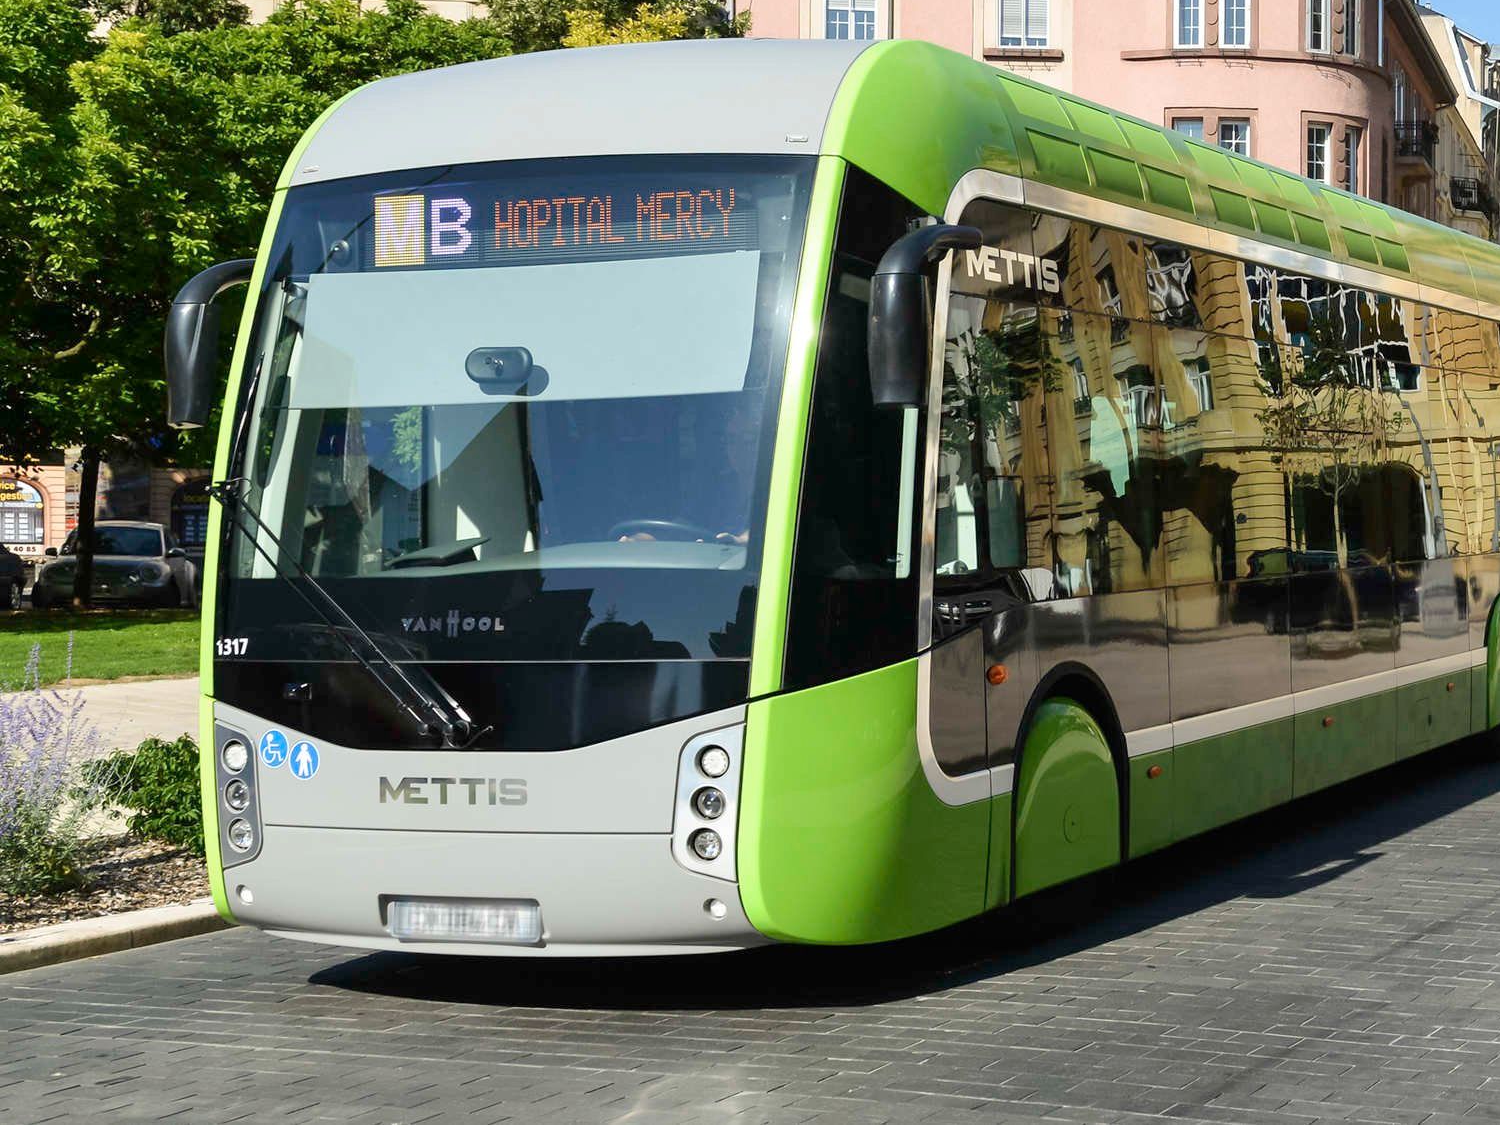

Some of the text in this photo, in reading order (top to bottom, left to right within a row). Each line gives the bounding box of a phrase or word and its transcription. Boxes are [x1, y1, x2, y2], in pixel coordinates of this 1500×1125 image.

[377, 187, 736, 262] M B HOPITAL MERCY
[965, 245, 1060, 293] METTIS
[216, 637, 249, 656] 1317
[379, 776, 528, 806] METTIS
